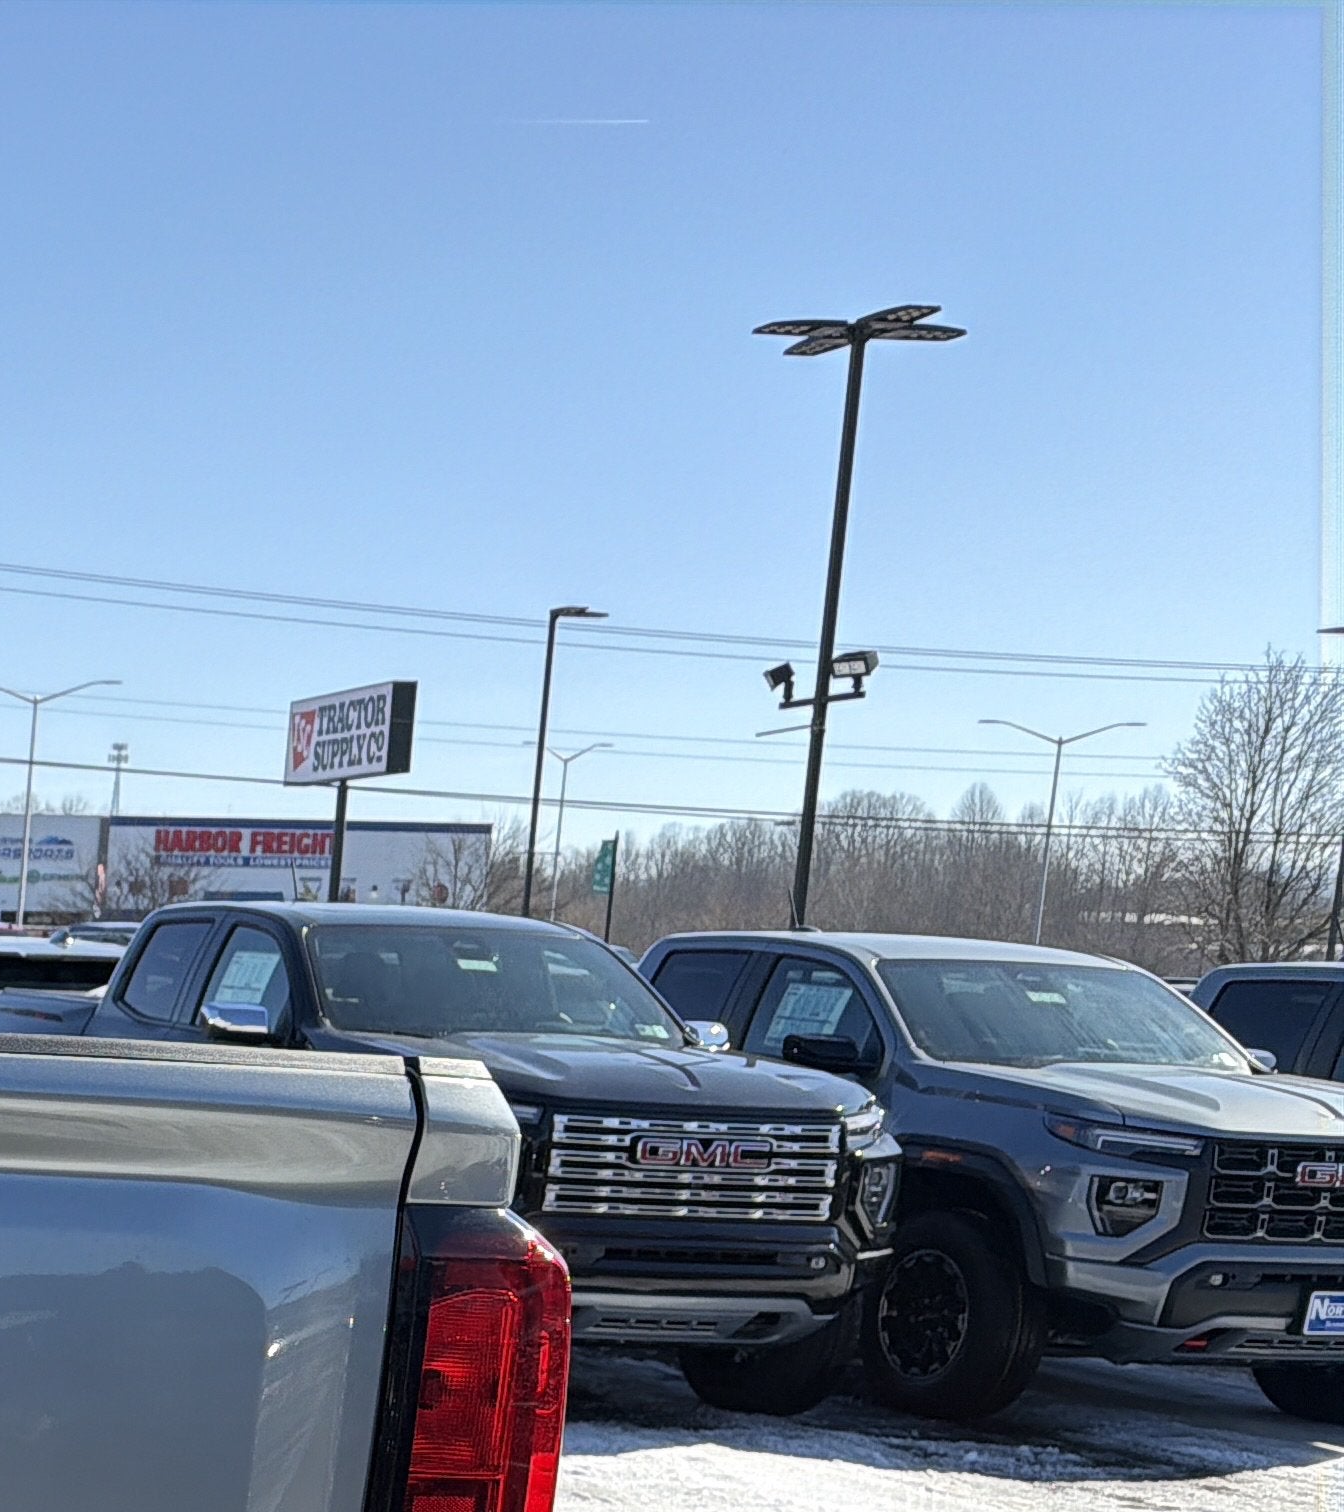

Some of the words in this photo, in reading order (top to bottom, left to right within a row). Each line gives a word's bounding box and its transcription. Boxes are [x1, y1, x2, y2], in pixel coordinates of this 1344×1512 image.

[317, 694, 387, 738] TRACTOR
[311, 732, 367, 773] SUPPLY
[155, 829, 242, 853] HARBOR
[249, 830, 335, 856] FREIGHT
[637, 1137, 771, 1168] GMC
